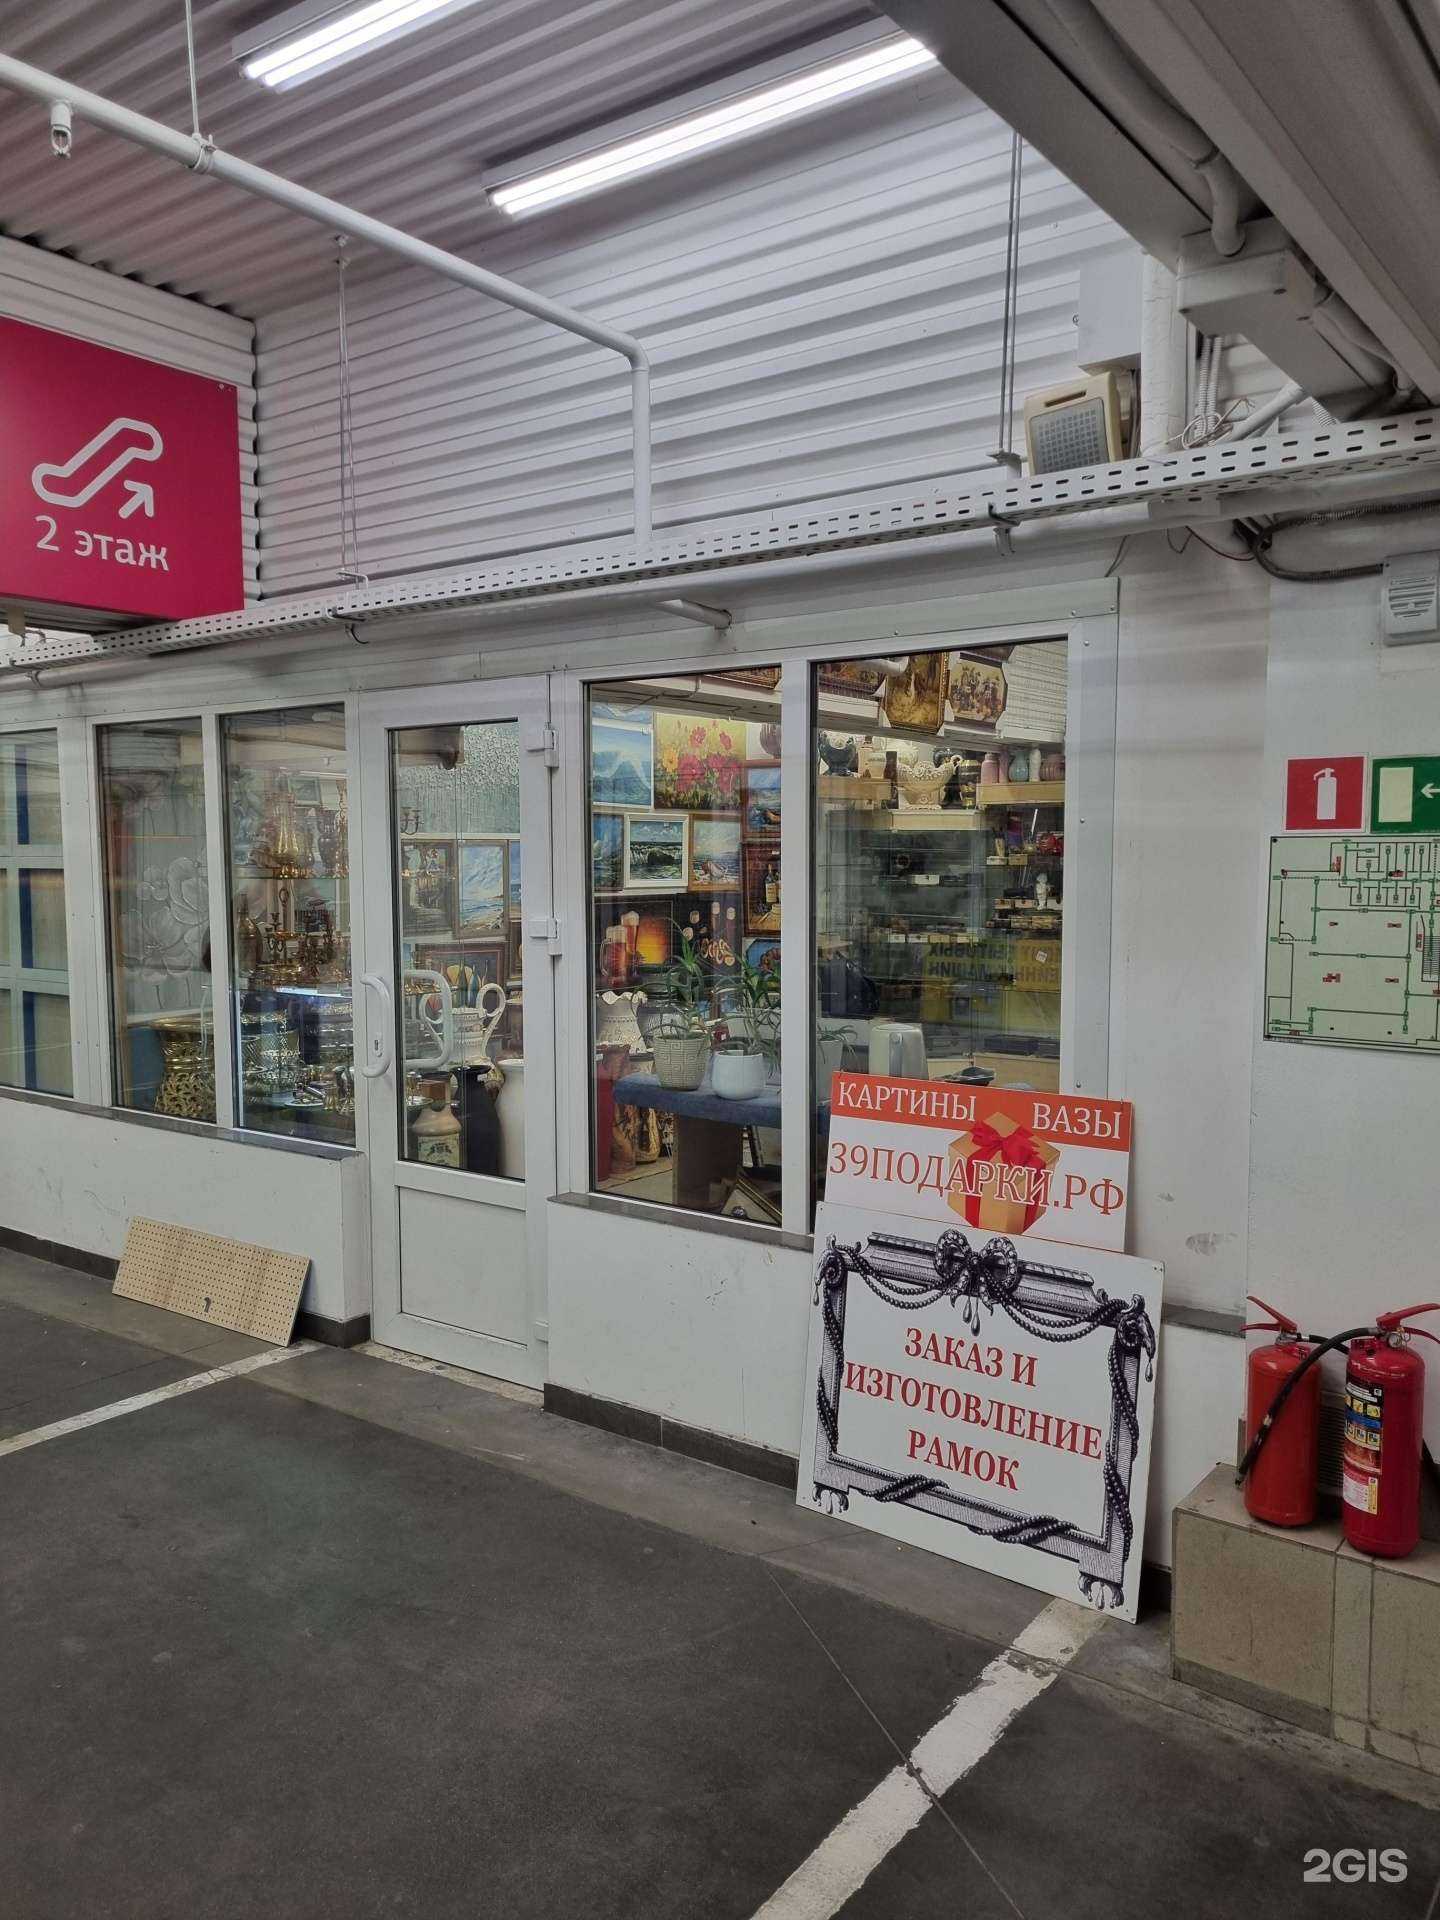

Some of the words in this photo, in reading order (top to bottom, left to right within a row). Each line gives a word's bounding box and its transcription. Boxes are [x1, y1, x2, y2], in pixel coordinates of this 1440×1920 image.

[35, 515, 60, 552] 2
[74, 529, 169, 571] этаж
[837, 1081, 977, 1122] КАРТИНЫ
[1032, 1102, 1122, 1139] ВАЗЫ
[829, 1142, 1125, 1215] 39ПОДАРКИ.РФ
[904, 1327, 1003, 1378] ЗАКАЗ
[1011, 1352, 1038, 1387] И
[845, 1361, 1102, 1460] ИЗГОТОВЛЕНИЕ
[907, 1429, 1020, 1491] РАМОК
